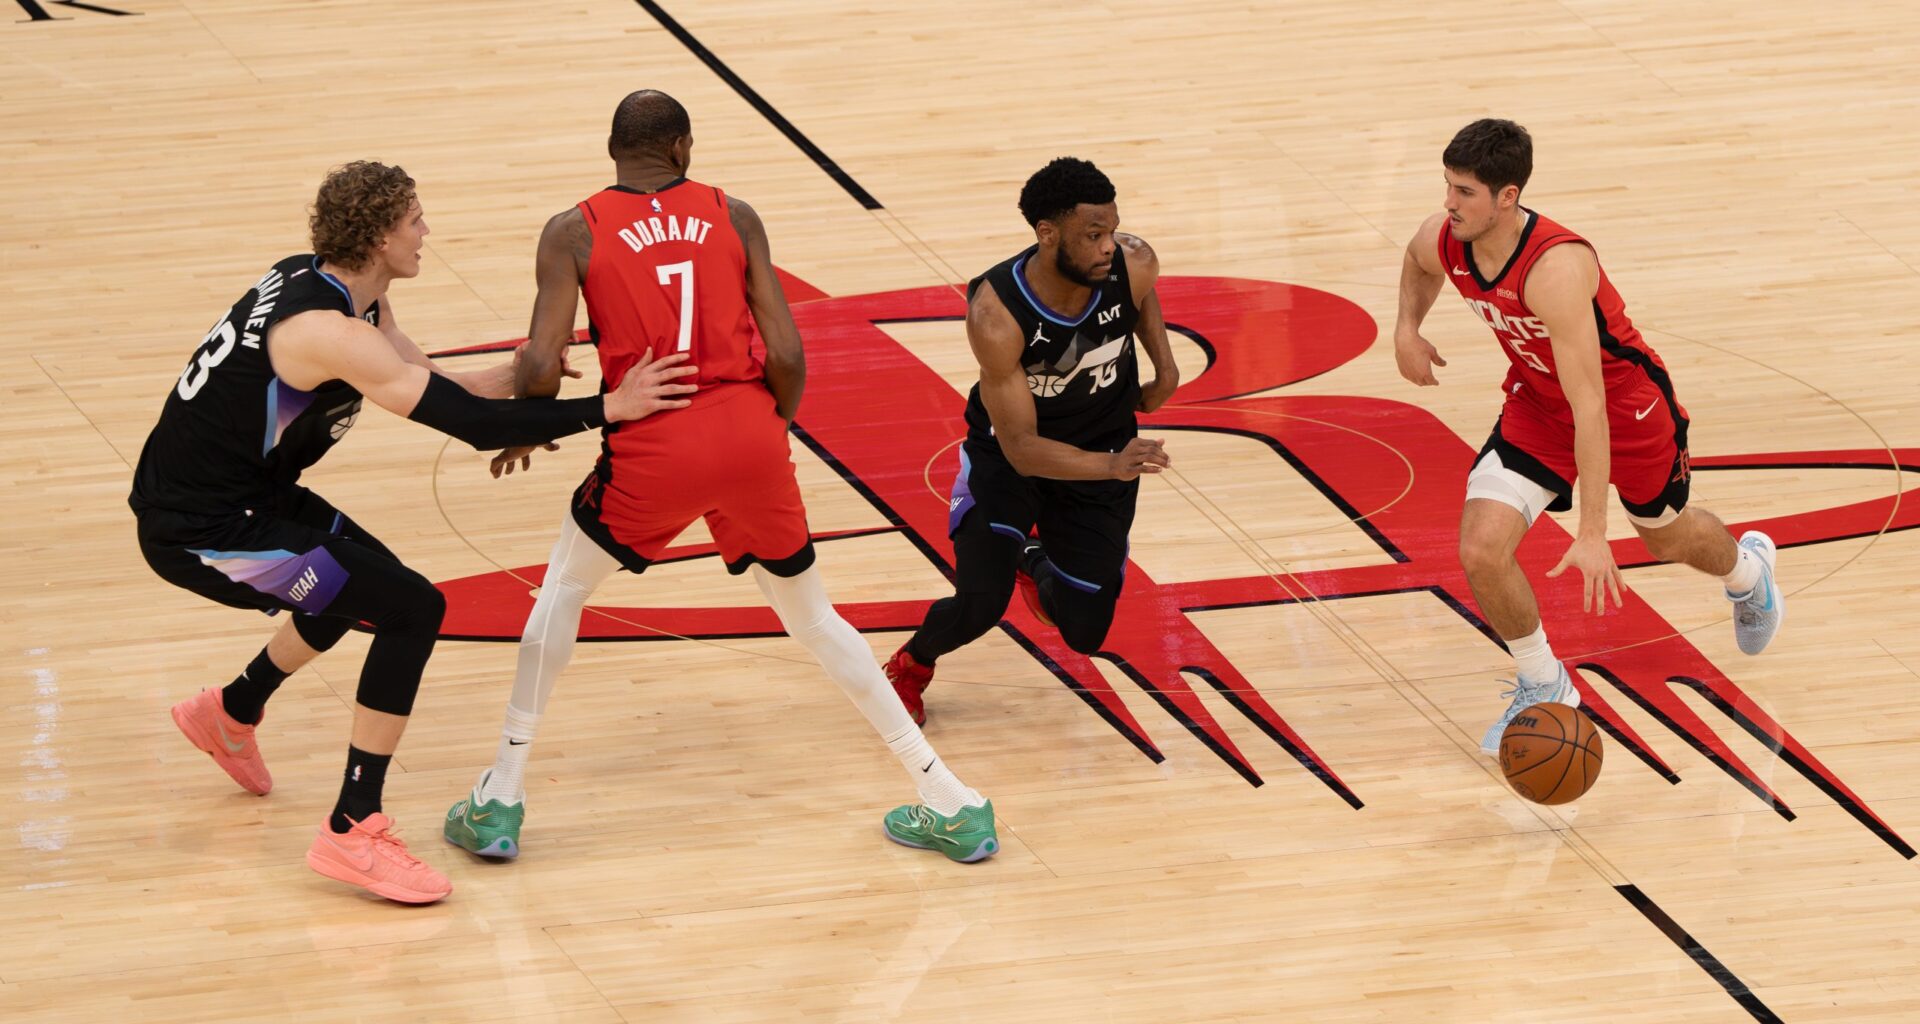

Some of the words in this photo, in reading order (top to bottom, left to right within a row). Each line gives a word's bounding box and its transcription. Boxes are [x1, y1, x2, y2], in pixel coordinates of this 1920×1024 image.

[617, 215, 713, 253] DURANT
[655, 260, 694, 352] 7
[1097, 303, 1122, 325] LVT
[177, 308, 237, 401] 3
[288, 565, 319, 602] UTAH
